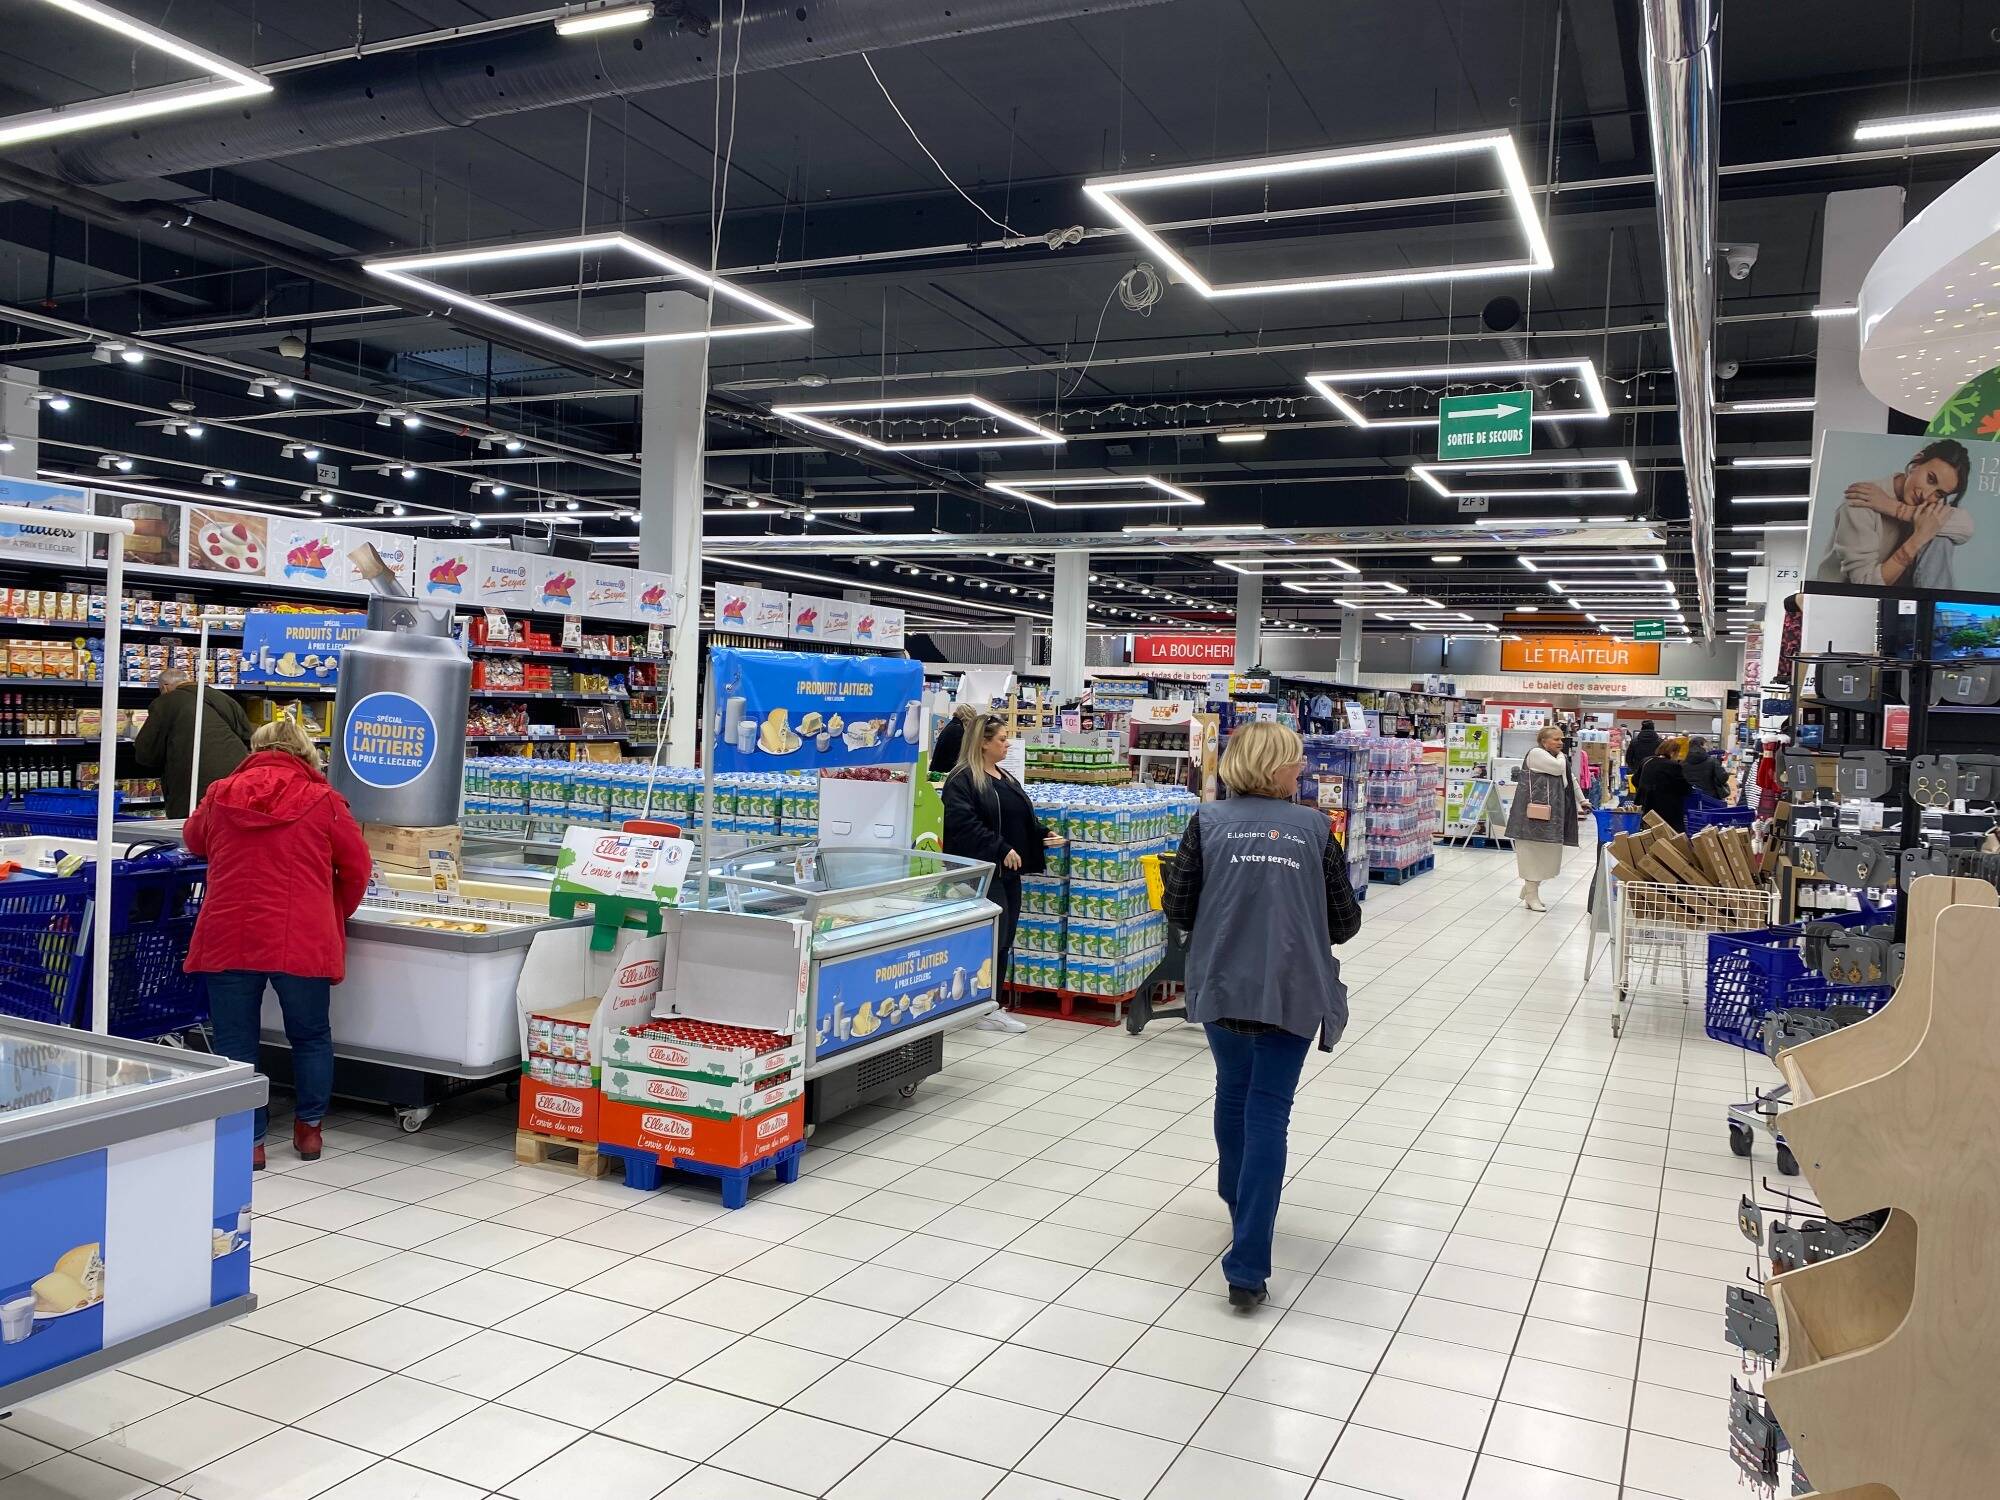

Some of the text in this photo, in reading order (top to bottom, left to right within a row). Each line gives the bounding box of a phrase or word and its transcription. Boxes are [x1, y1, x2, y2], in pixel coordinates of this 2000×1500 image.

[1447, 428, 1524, 446] SORTIE DE SECOURS
[319, 468, 337, 480] ZF 3
[1462, 497, 1485, 506] ZF 3
[491, 565, 518, 575] E.Leclerc
[1777, 570, 1799, 578] ZF 3
[482, 575, 527, 589] La Seyne
[604, 589, 626, 601] Seyne
[286, 626, 333, 640] PRODUITS
[1152, 643, 1233, 658] LA BOUCHERI
[1525, 649, 1629, 665] LE TRAITEUR
[800, 680, 838, 695] PRODUITS
[838, 681, 874, 696] LAITIERS
[1522, 681, 1534, 689] Le
[1567, 681, 1585, 691] des
[1587, 683, 1627, 692] saveurs
[376, 714, 403, 724] SPÉCIAL
[354, 720, 426, 741] PRODUITS
[352, 735, 424, 757] LAITIERS
[352, 752, 422, 768] À PRIX E.LECLERC
[1460, 751, 1488, 760] EASY
[1227, 831, 1266, 839] E.Leclerc
[580, 861, 613, 879] L'envie
[1229, 854, 1301, 870] A votre service
[875, 949, 949, 984] PRODUITS LAITIERS
[898, 978, 909, 988] PRIX
[909, 971, 932, 986] E.LECLERC
[529, 1112, 584, 1135] L'envie du vrai
[637, 1133, 695, 1157] L'envie du vrai
[771, 1136, 780, 1149] du
[779, 1133, 790, 1147] vrai
